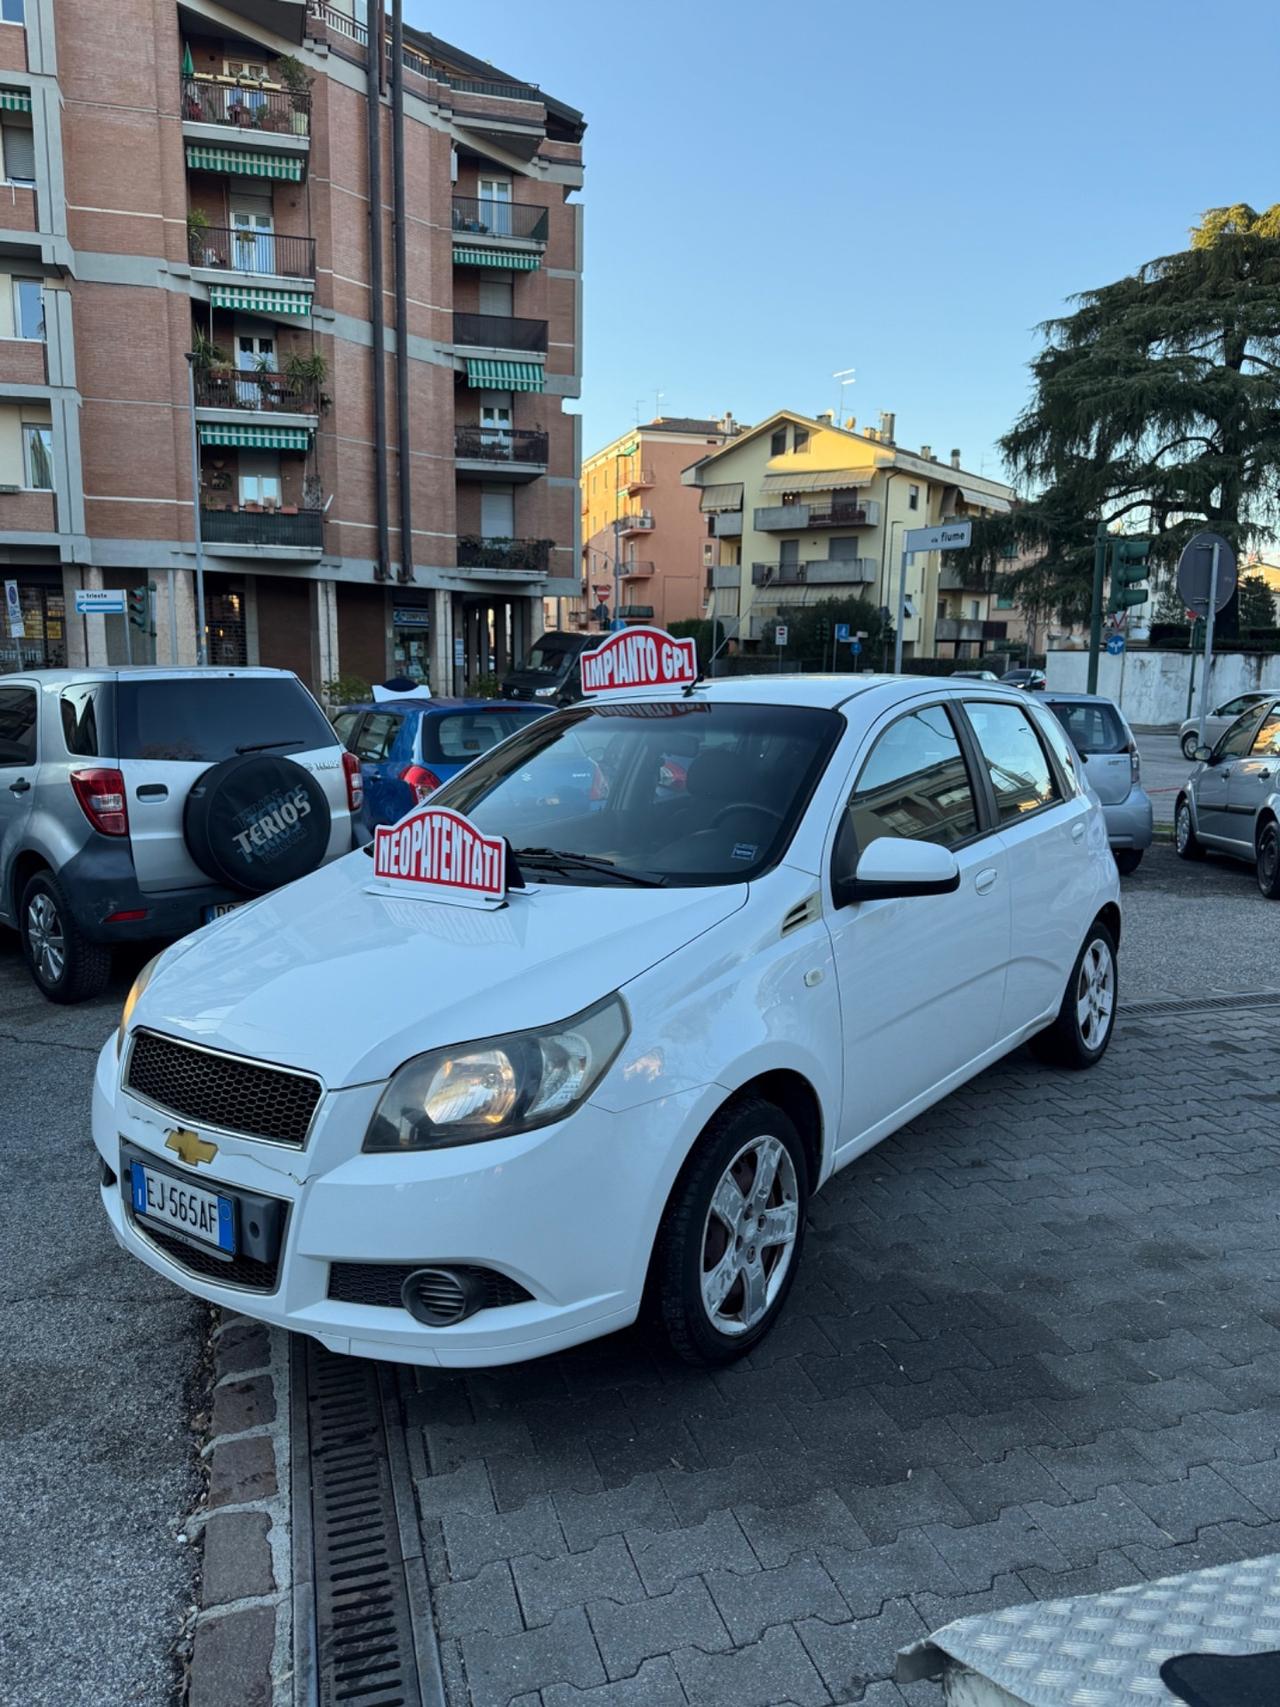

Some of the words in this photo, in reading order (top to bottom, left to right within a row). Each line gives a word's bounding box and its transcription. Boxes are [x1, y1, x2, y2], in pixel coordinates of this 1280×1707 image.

[941, 531, 965, 542] fiume
[585, 636, 658, 688] IMPIANTO
[661, 643, 693, 680] GPL
[232, 793, 312, 854] TERIOS
[378, 814, 499, 889] NEOPATENTATI
[146, 1177, 165, 1211] EJ
[169, 1187, 217, 1233] 565AF
